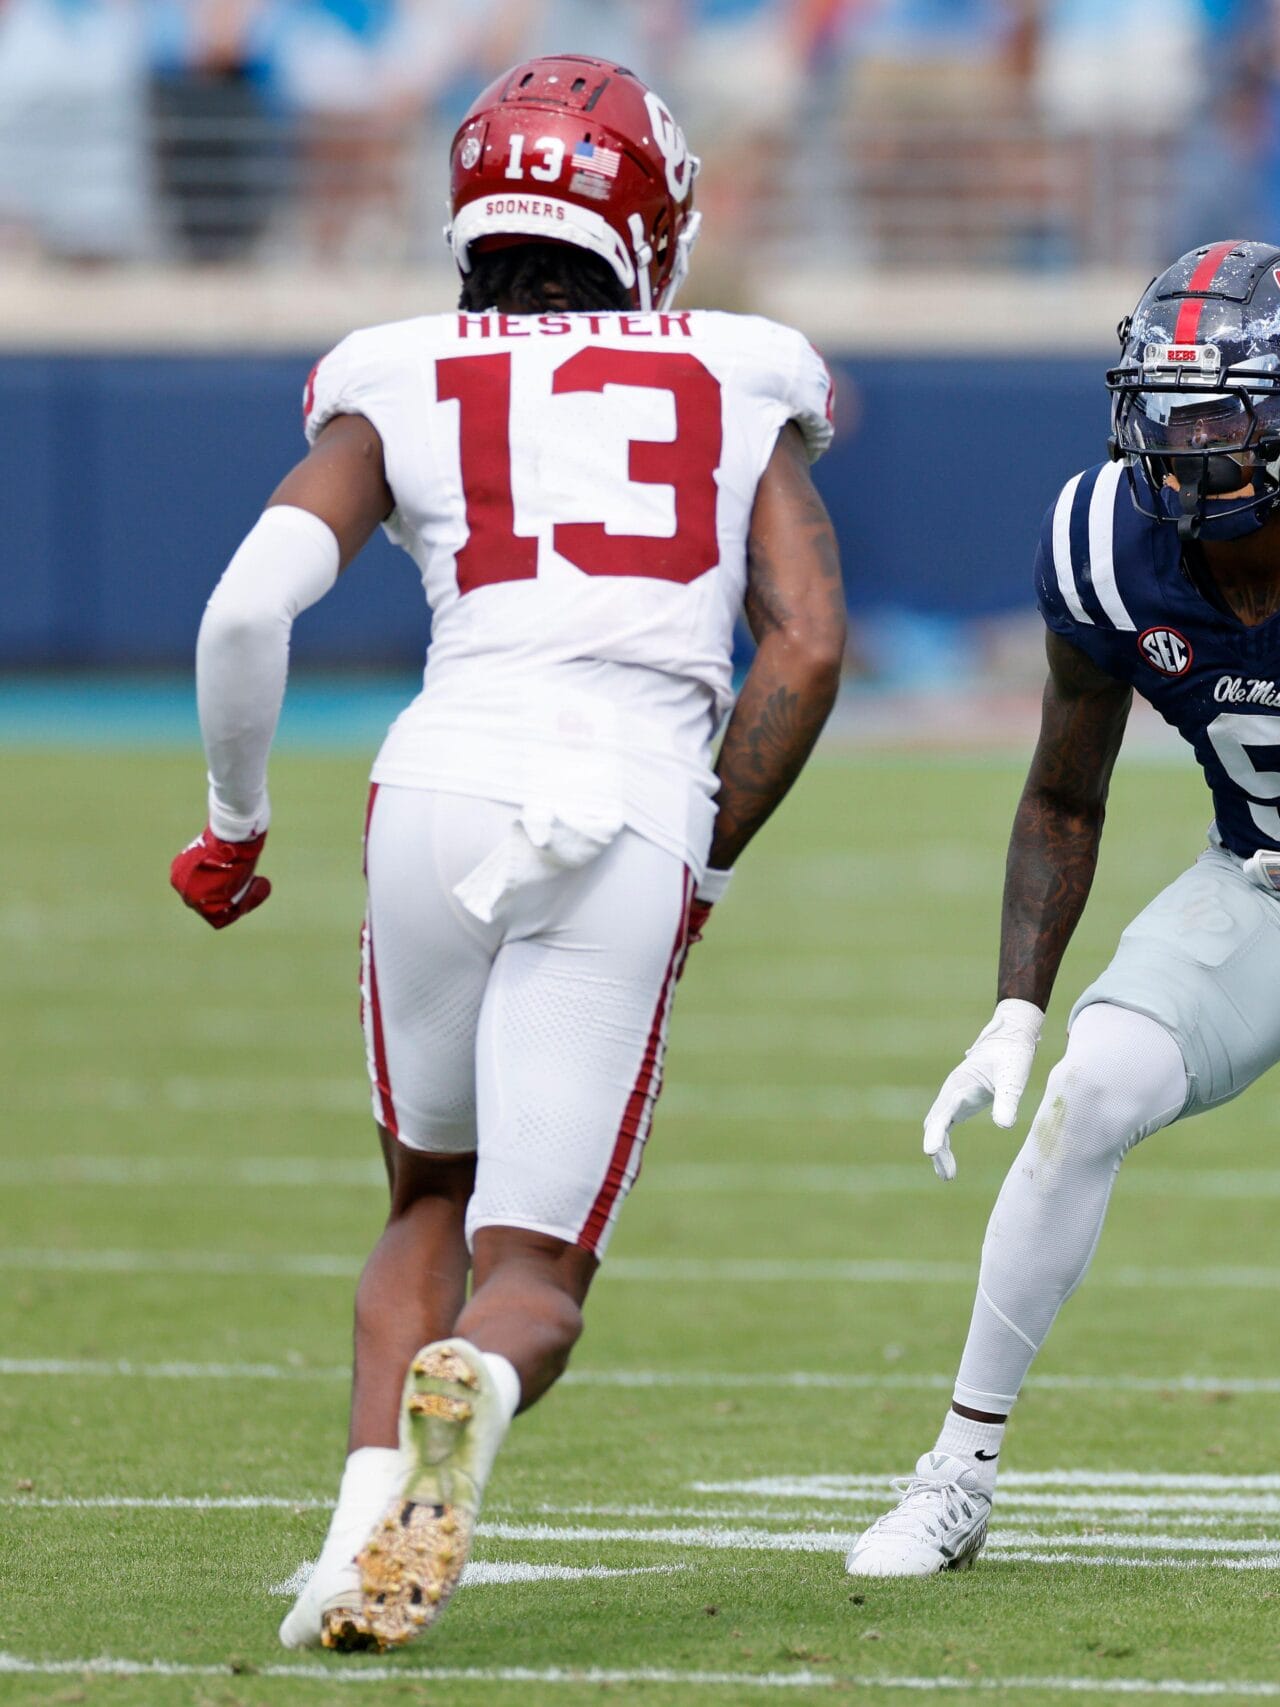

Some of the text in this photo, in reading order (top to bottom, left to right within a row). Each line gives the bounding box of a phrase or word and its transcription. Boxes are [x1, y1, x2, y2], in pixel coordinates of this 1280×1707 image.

[505, 134, 566, 182] 13
[485, 200, 566, 221] SOONERS
[457, 313, 693, 338] HESTER
[1167, 350, 1197, 361] REBS
[435, 346, 723, 598] 13
[1142, 631, 1188, 673] SEC
[1213, 675, 1246, 703] Ole
